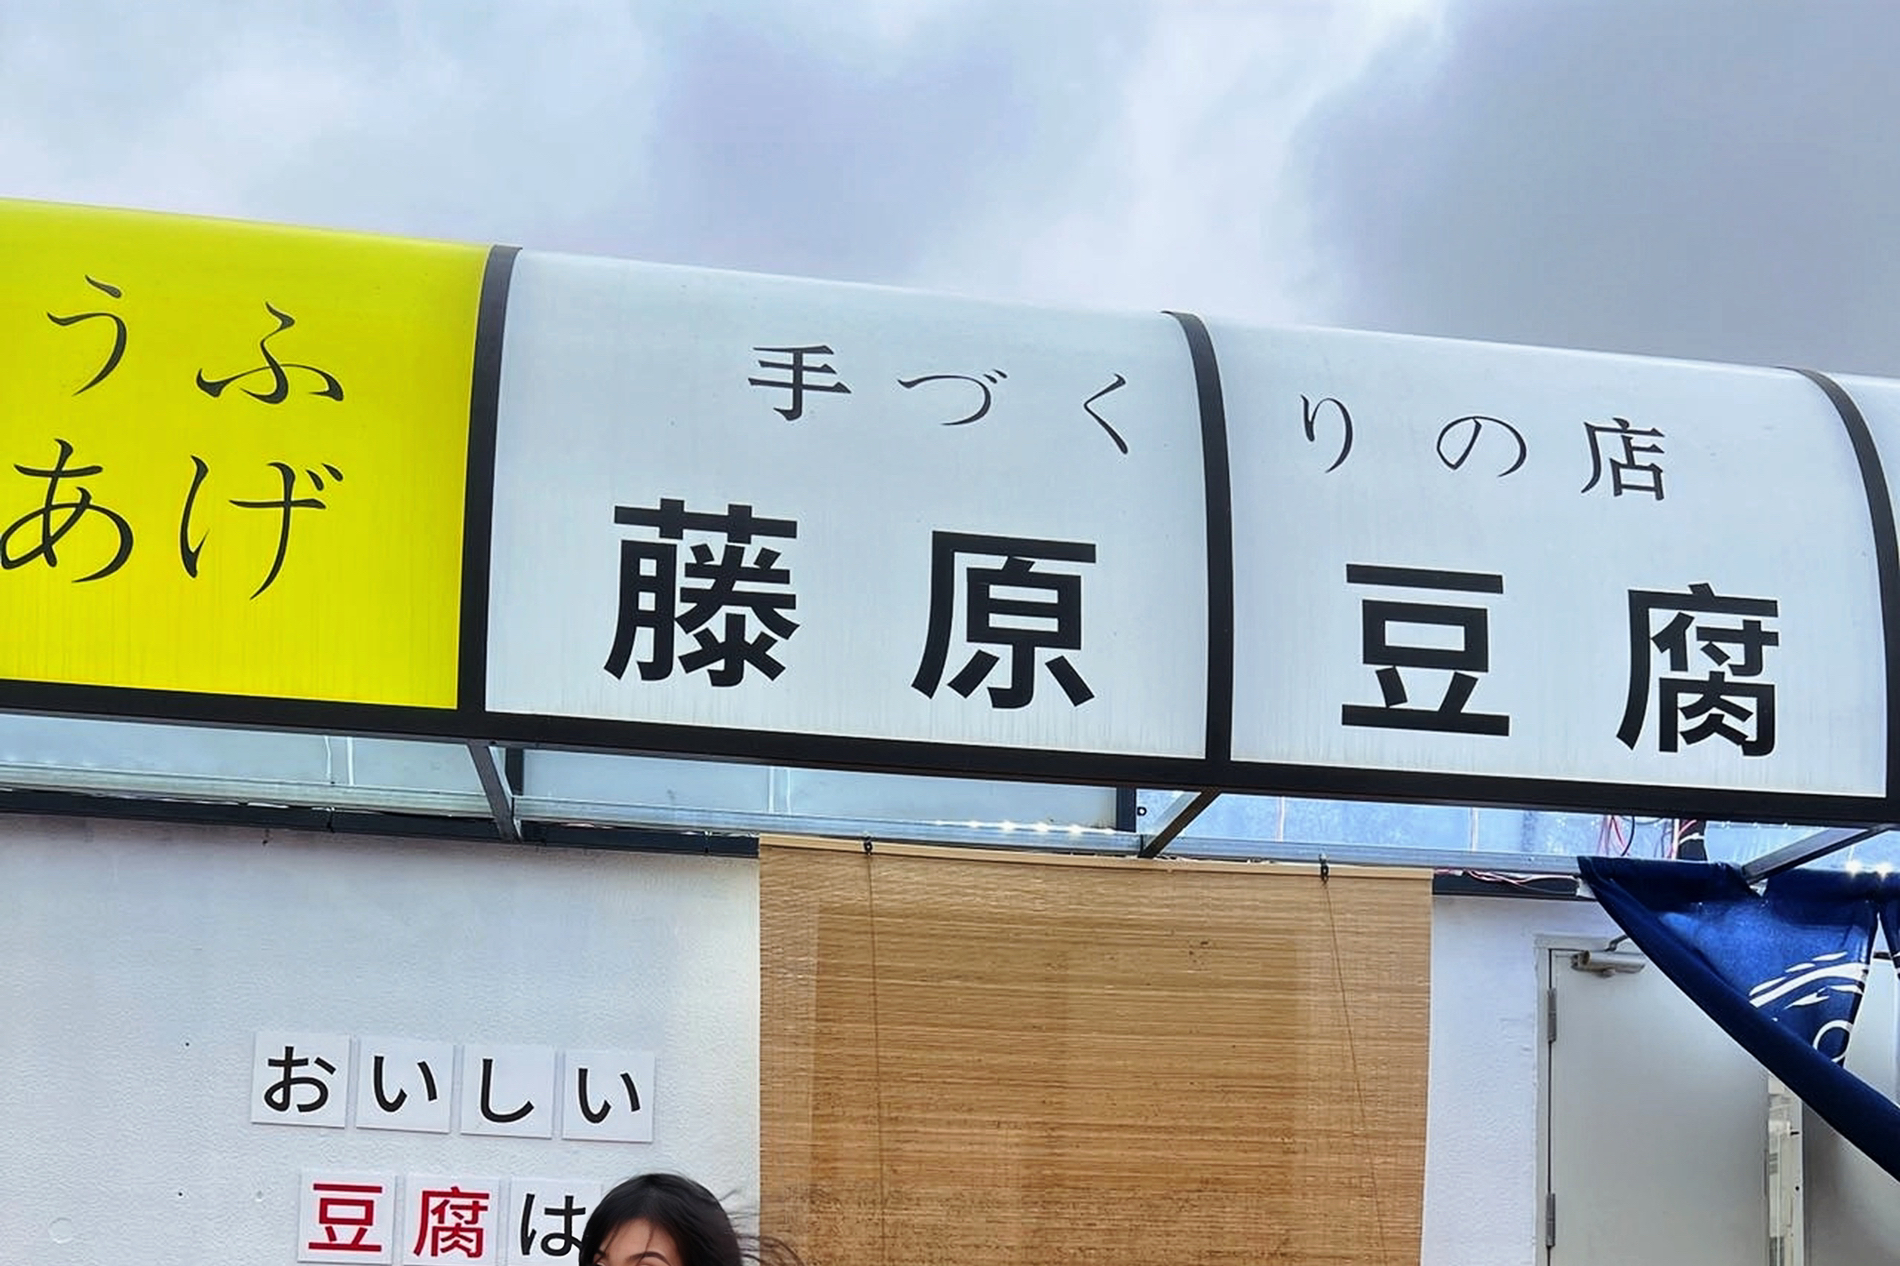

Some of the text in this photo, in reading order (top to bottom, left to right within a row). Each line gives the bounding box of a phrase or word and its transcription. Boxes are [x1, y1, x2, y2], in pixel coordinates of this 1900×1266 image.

[46, 274, 344, 405] うふ
[748, 344, 1666, 501] 手づくりの店
[0, 437, 344, 601] あげ
[603, 497, 1780, 757] 藤原豆腐
[263, 1045, 641, 1124] おいしい
[307, 1182, 586, 1259] 豆腐は
